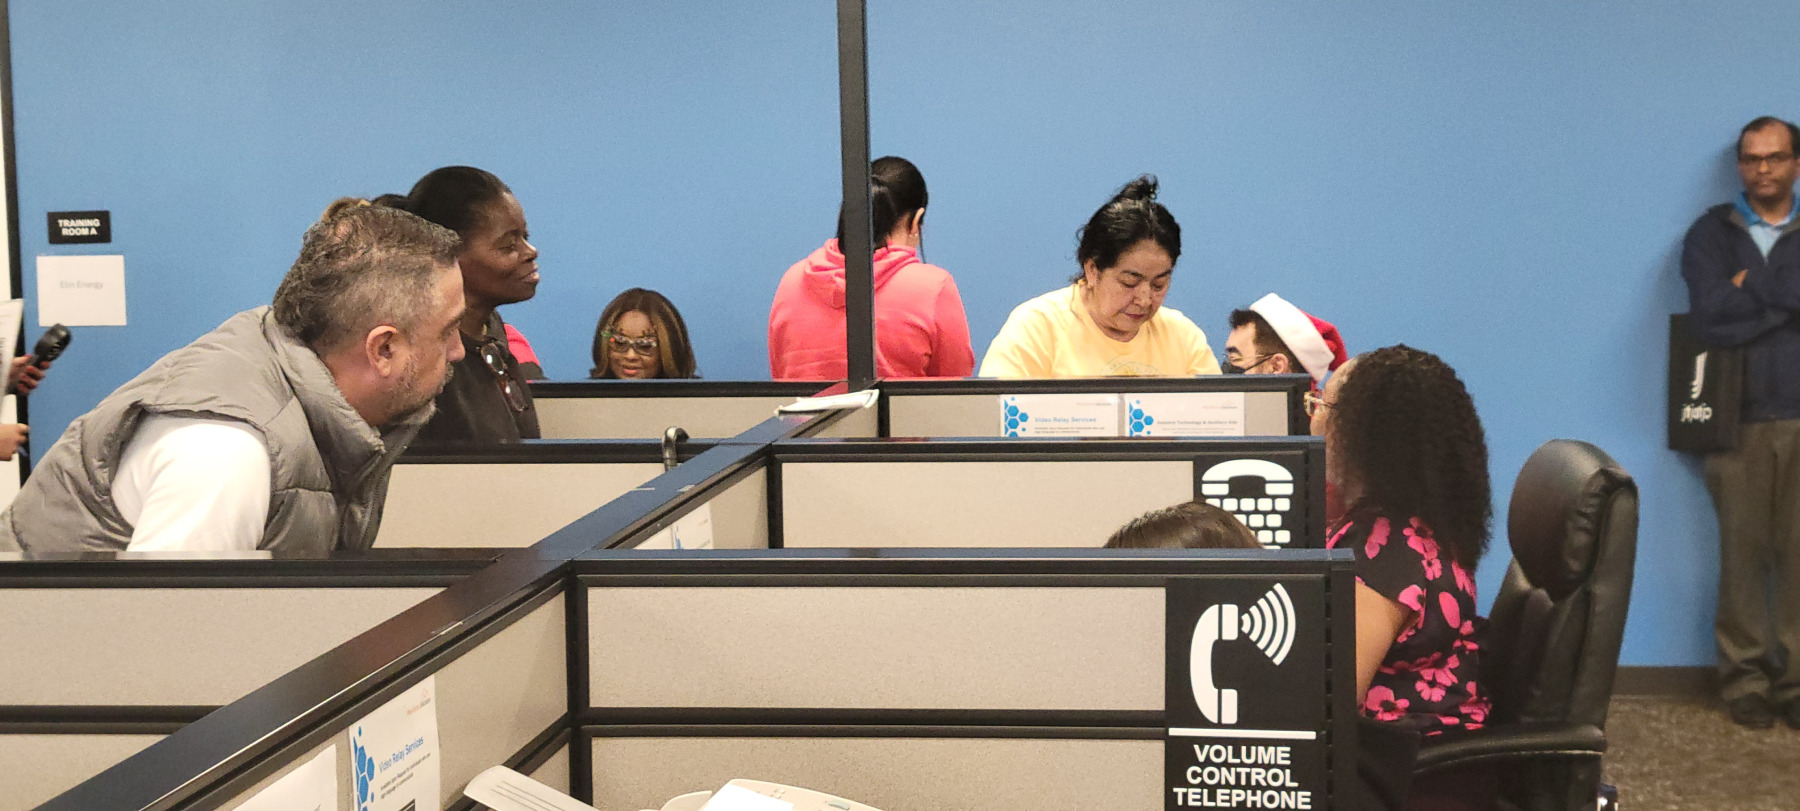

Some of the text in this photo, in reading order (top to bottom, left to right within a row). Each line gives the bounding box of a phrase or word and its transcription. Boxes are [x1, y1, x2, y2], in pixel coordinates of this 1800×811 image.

[57, 218, 100, 228] TRAINING
[61, 227, 98, 236] ROOM A
[76, 280, 104, 290] Energy
[1053, 416, 1070, 424] Relay
[379, 736, 424, 772] Video Relay Services
[1193, 744, 1292, 766] VOLUME
[1186, 765, 1300, 788] CONTROL
[1172, 787, 1313, 811] TELEPHONE
